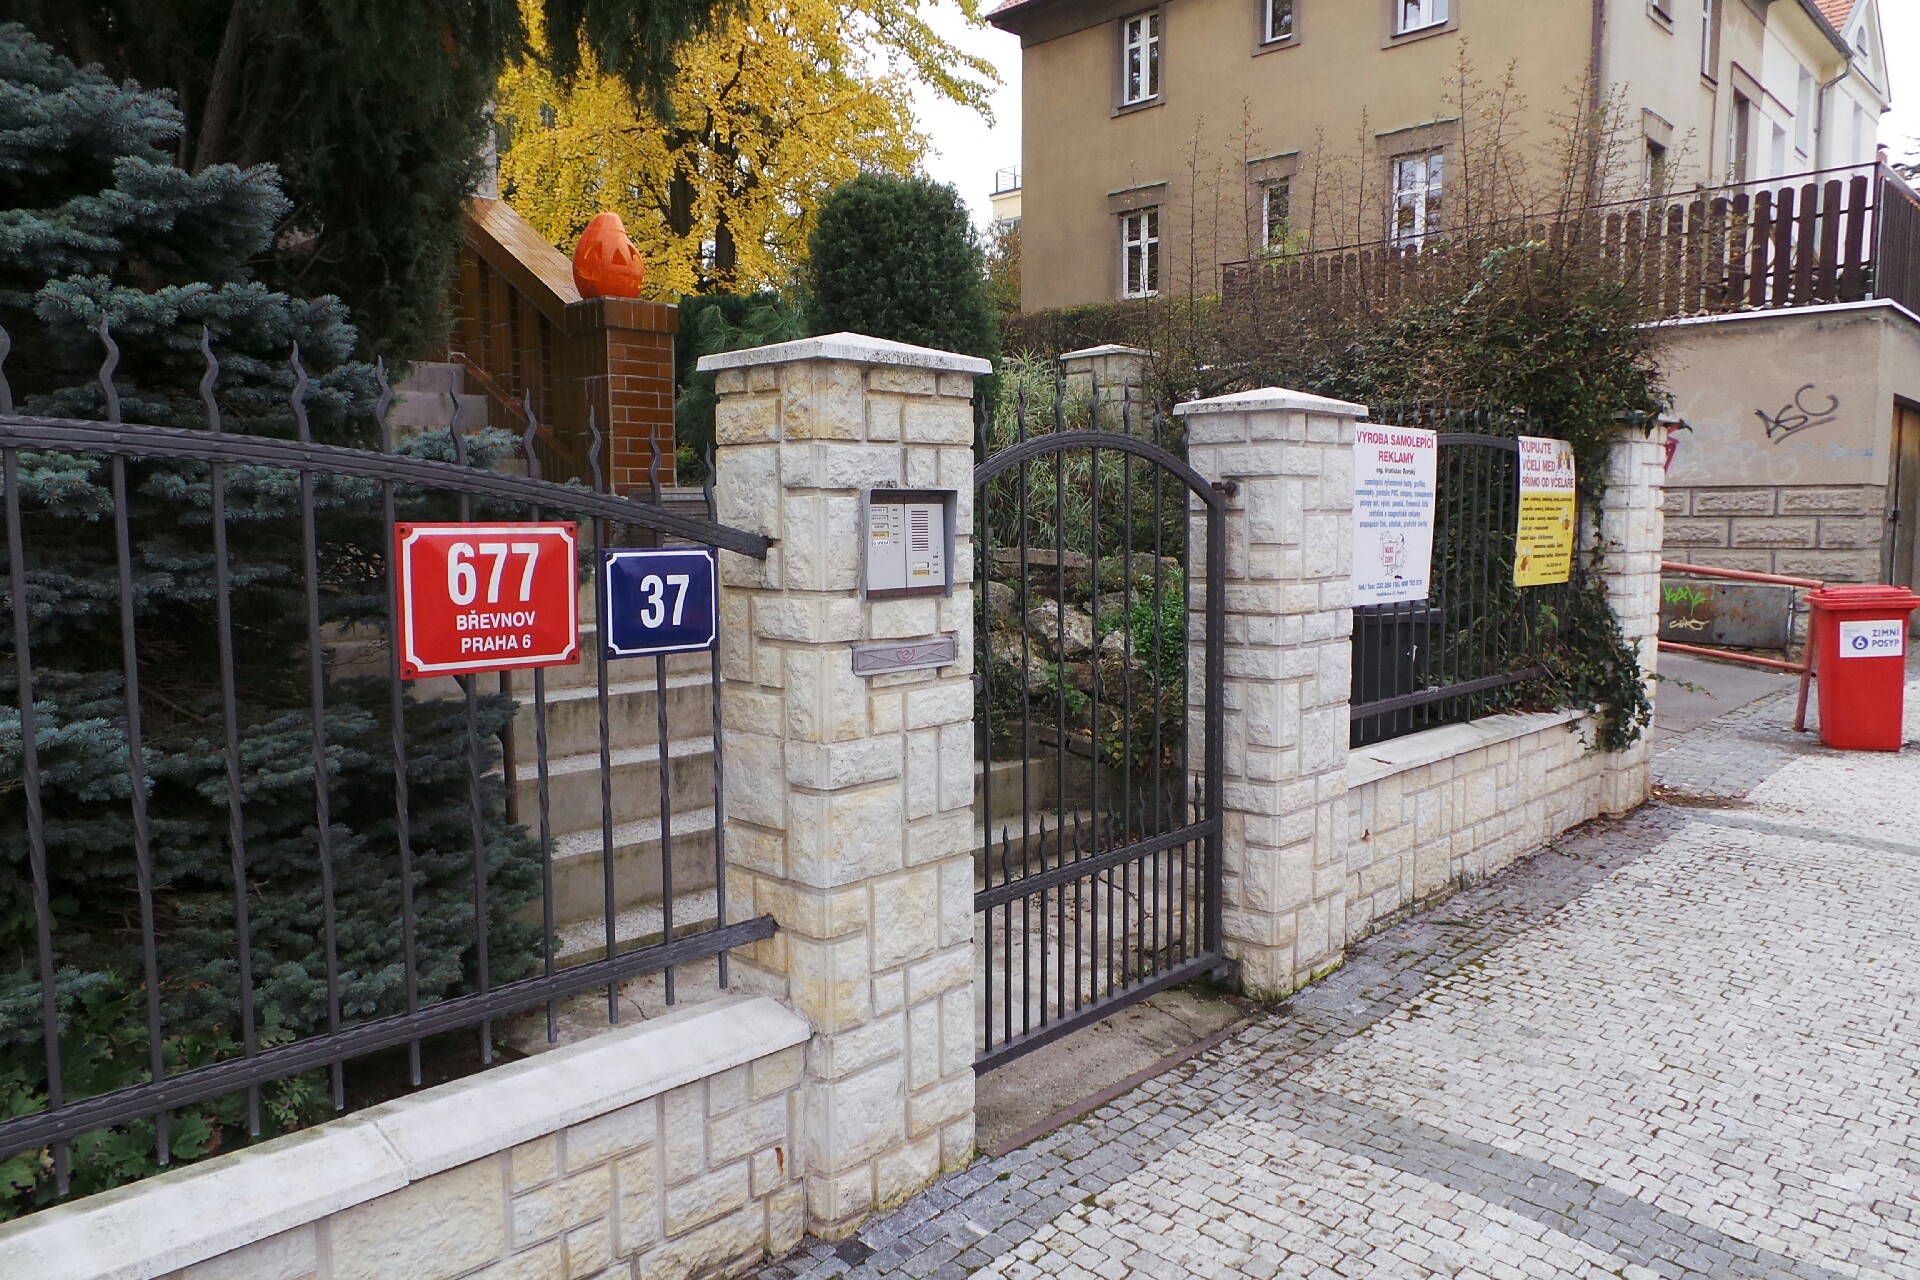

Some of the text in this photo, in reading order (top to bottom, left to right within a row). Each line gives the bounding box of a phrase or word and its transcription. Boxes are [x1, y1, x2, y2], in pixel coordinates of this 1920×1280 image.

[1357, 428, 1434, 449] VÝROBA SAMOLEPÍCÍ
[1521, 441, 1552, 454] KUPUJTE
[1378, 450, 1415, 463] REKLAMY
[1522, 456, 1556, 472] VČELÍ MED
[1522, 473, 1574, 488] PŘÍMO OD VČELAŘE
[446, 542, 540, 606] 677
[640, 574, 690, 629] 37
[456, 609, 536, 631] BŘEVNOV
[1872, 627, 1900, 637] ZIMNÍ
[460, 634, 532, 654] PRAHA 6
[1871, 639, 1900, 647] POSYP
